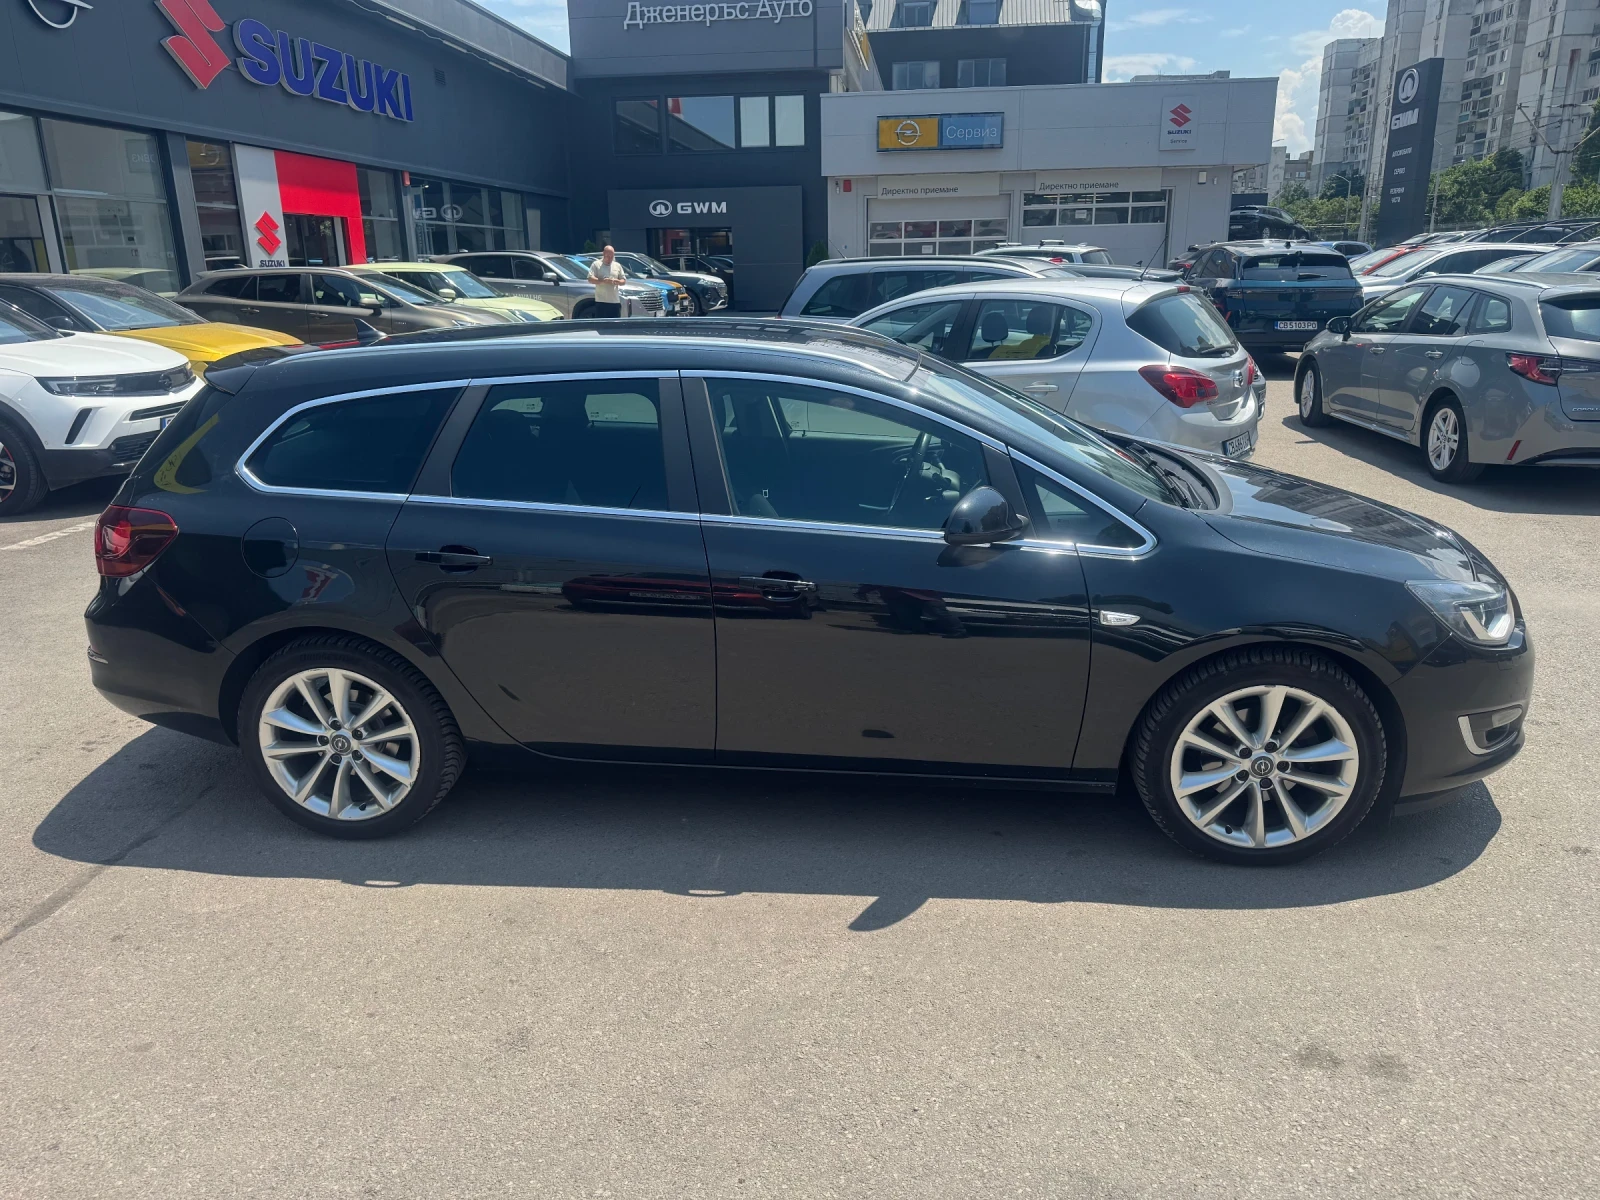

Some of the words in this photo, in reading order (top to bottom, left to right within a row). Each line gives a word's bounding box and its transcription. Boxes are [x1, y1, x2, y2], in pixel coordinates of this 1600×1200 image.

[623, 2, 749, 30] Дженеръс
[755, 0, 813, 24] Ауто
[233, 18, 414, 123] SUZUKI
[1391, 108, 1420, 130] GWM
[946, 125, 997, 140] Сервиз
[881, 187, 919, 196] Директно
[920, 185, 959, 195] приемане
[1039, 182, 1078, 192] Директно
[1079, 181, 1119, 191] приемане
[676, 201, 727, 214] GWM
[259, 260, 286, 268] SUZUKI
